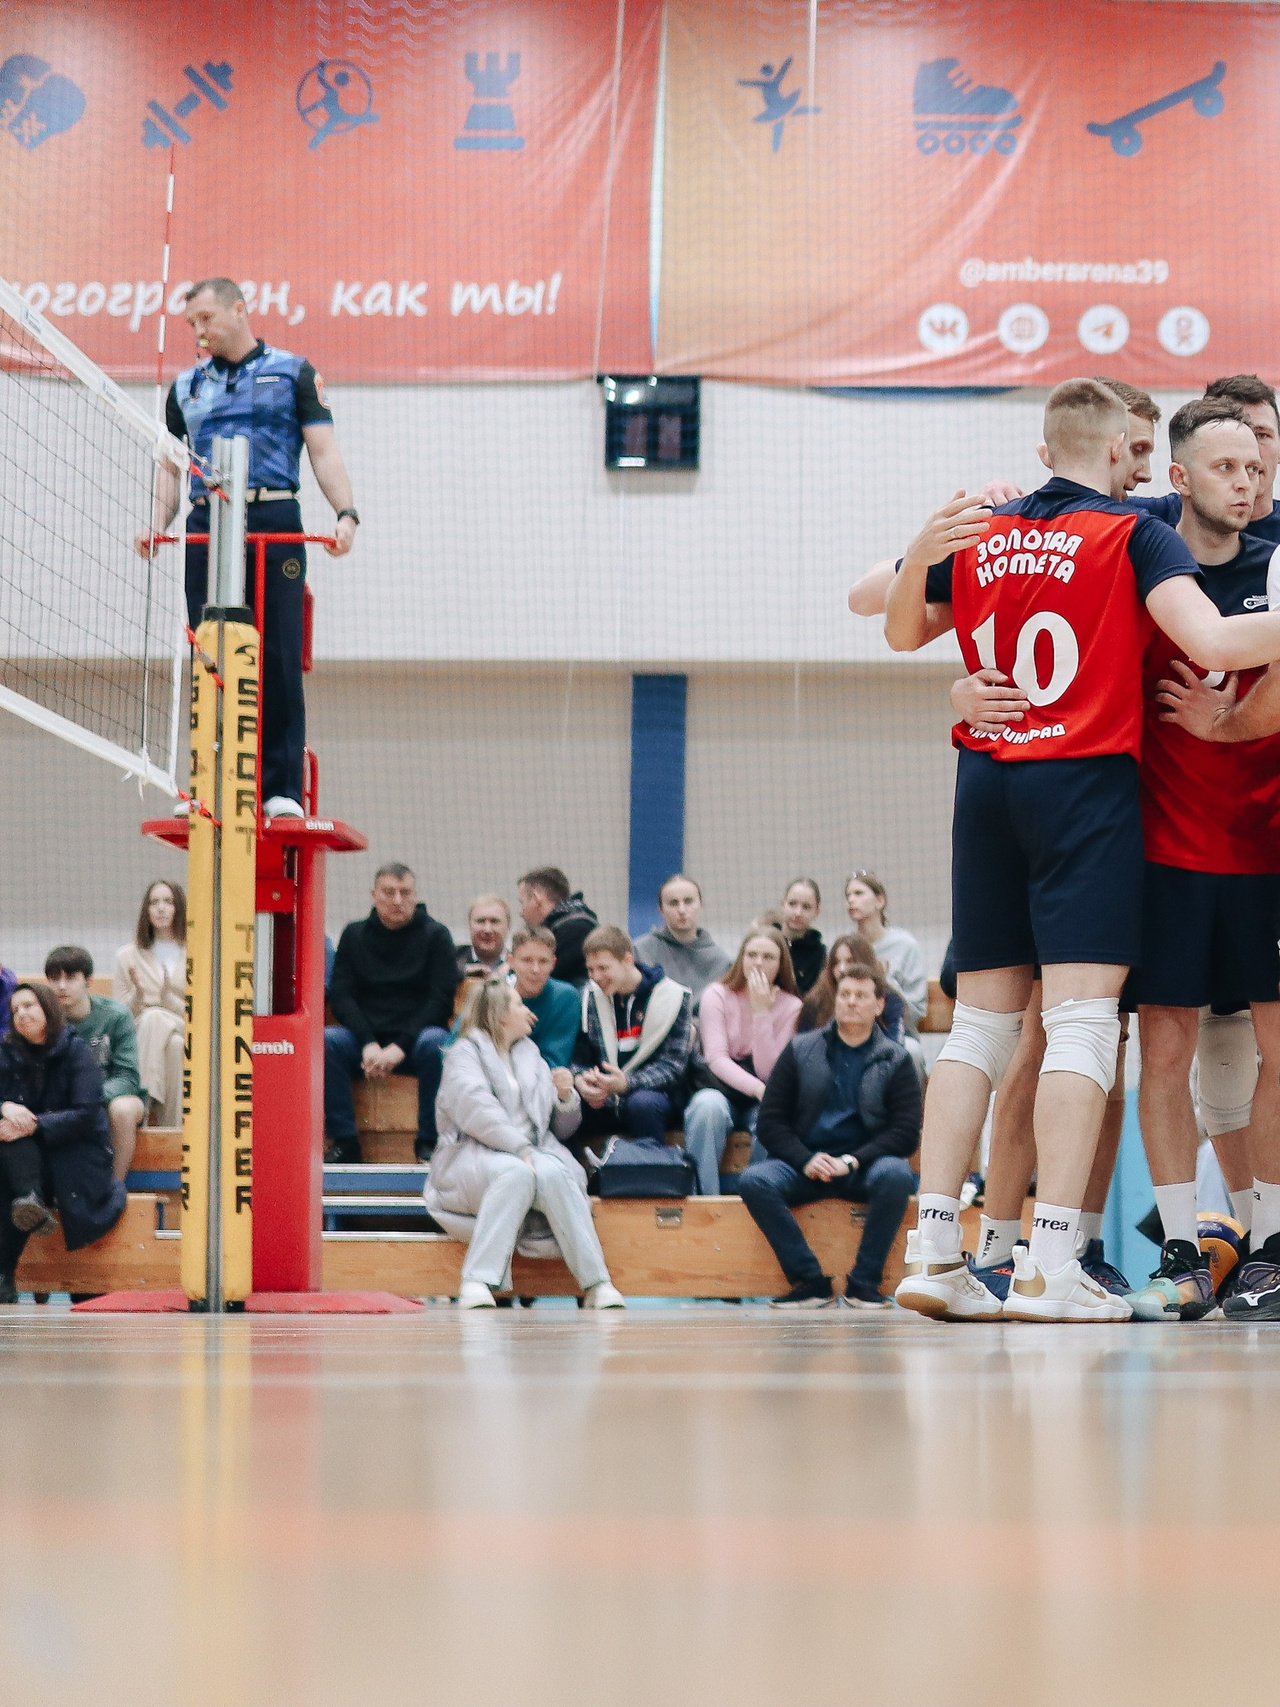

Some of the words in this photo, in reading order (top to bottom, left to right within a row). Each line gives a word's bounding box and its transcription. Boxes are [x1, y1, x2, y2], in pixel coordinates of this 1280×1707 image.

[8, 279, 306, 332] огограен,
[331, 280, 429, 317] как
[451, 271, 563, 317] ты!
[975, 552, 1076, 588] КОМЕТА
[970, 611, 1080, 708] 10
